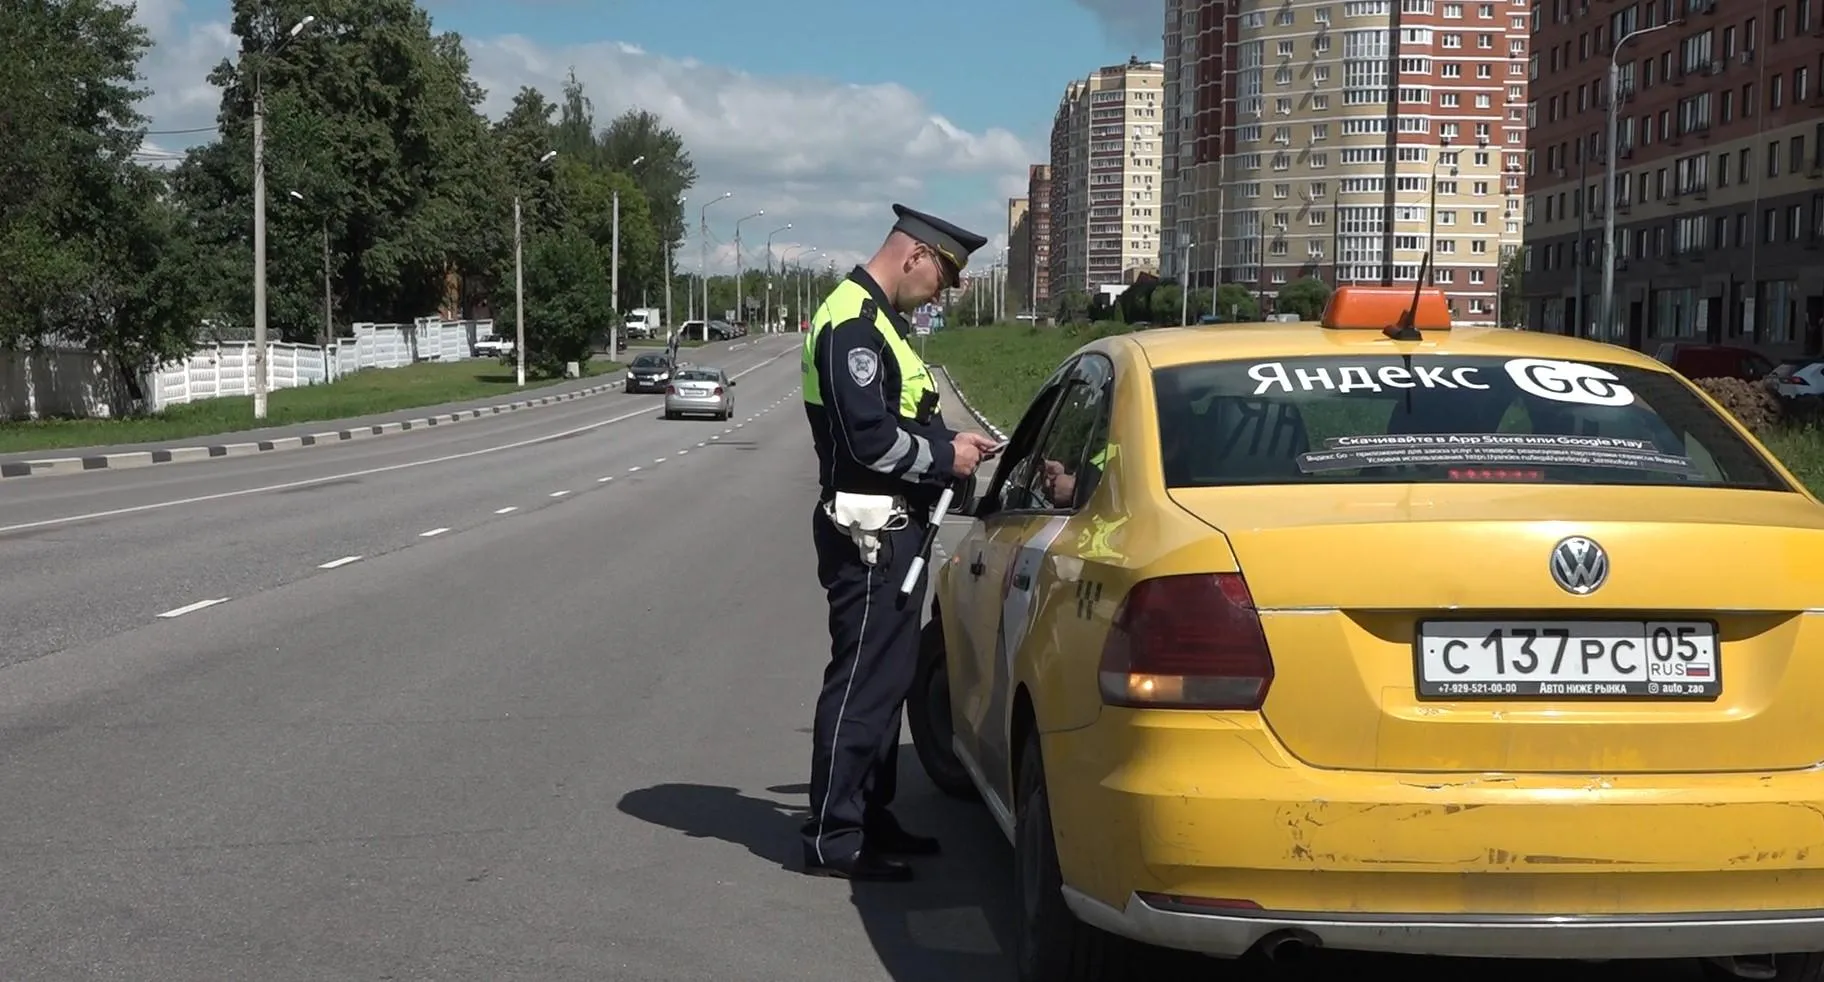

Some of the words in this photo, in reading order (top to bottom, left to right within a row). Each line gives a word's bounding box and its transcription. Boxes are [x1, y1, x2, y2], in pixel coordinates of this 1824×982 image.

[1248, 362, 1490, 395] Яндекс
[1522, 363, 1621, 401] Go
[1339, 435, 1433, 446] Скачивайте
[1448, 436, 1481, 445] App
[1482, 435, 1524, 444] Store
[1526, 437, 1556, 445] или
[1557, 437, 1611, 447] Google
[1612, 439, 1643, 449] Play
[1652, 627, 1698, 662] 05
[1651, 663, 1685, 676] RUS
[1438, 683, 1518, 694] +7-929-521-00-00
[1662, 683, 1705, 694] auto_zao
